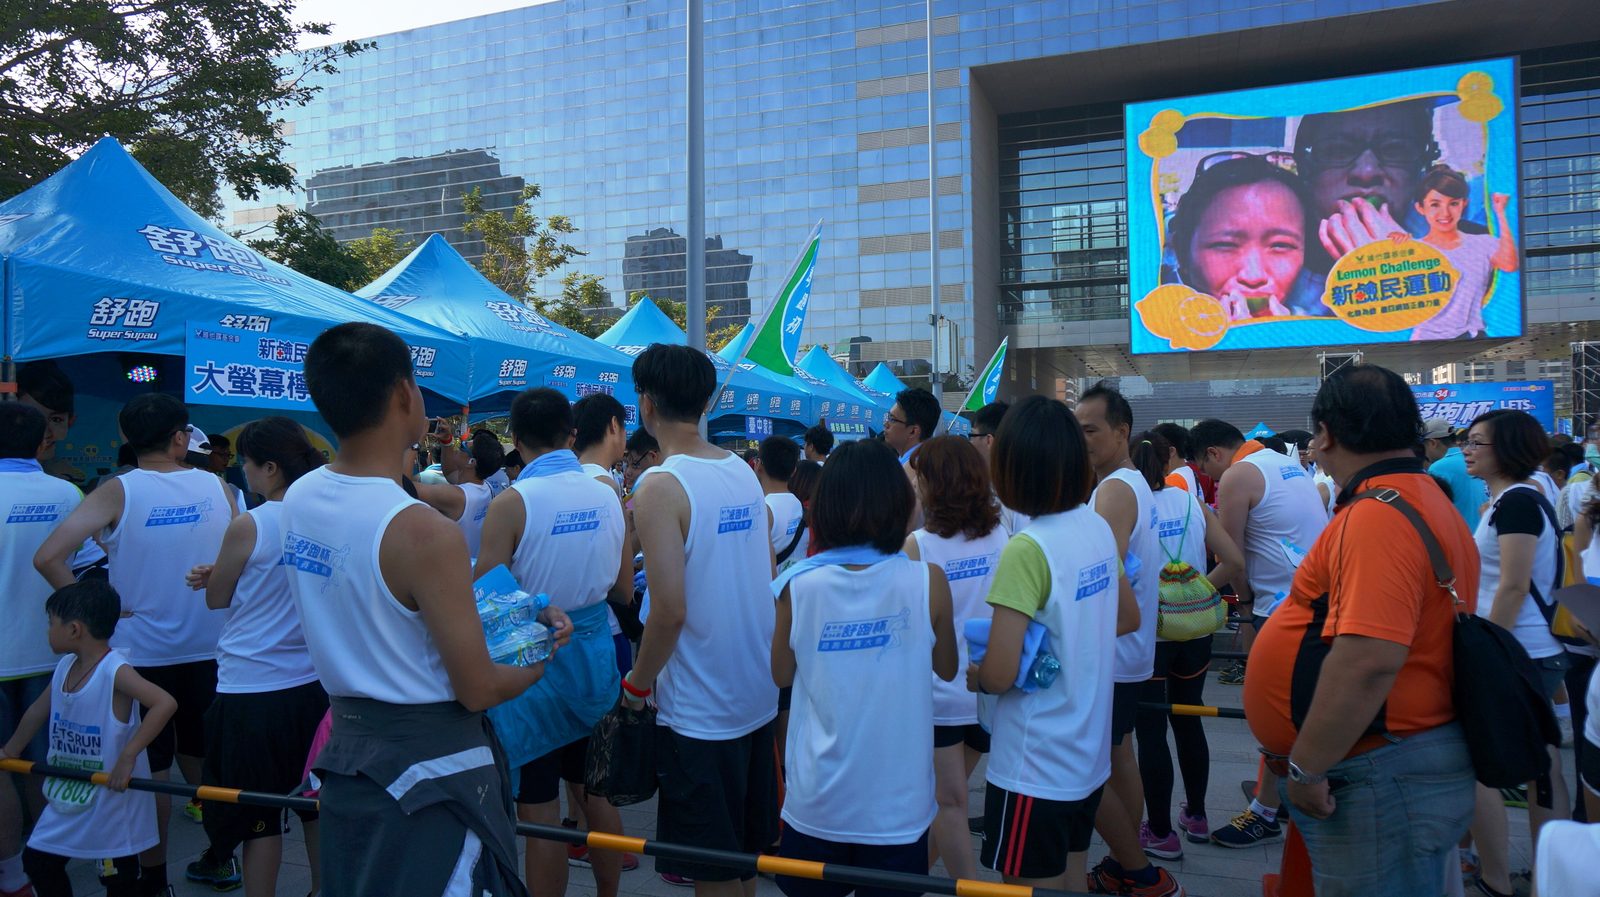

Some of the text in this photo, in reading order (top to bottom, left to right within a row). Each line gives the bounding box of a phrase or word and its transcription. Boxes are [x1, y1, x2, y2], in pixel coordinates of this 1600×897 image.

[136, 223, 268, 272] 舒跑
[161, 254, 228, 273] Super
[1336, 257, 1441, 281] Lemon Challenge
[90, 296, 160, 328] 舒跑
[87, 328, 158, 341] Super Supau
[498, 358, 529, 378] 舒跑
[569, 510, 598, 523] 舒跑杯
[841, 619, 889, 638] 舒跑杯
[53, 722, 102, 749] LTSRUN
